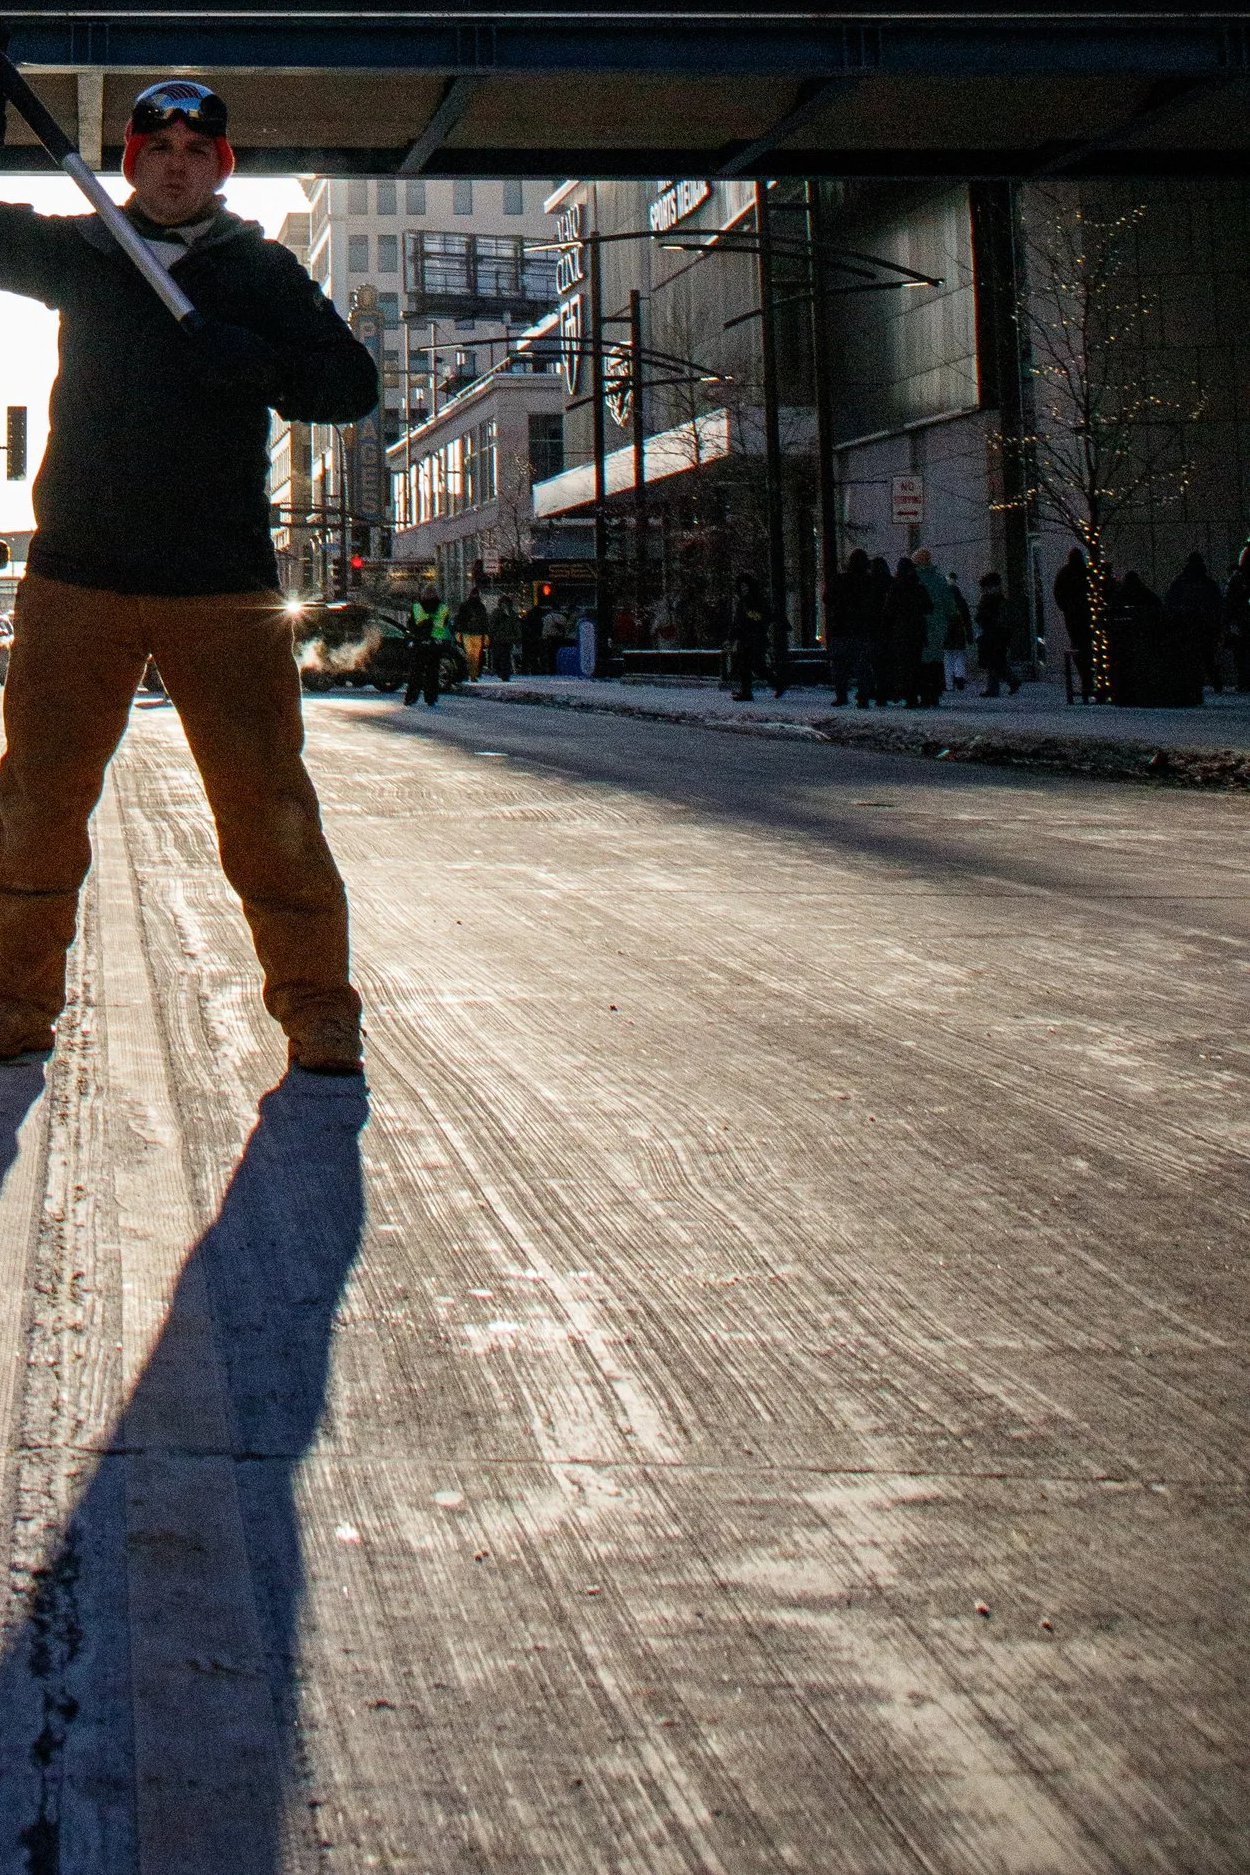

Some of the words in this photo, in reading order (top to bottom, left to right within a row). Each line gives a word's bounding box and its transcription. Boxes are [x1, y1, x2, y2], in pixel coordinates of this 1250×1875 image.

[649, 187, 677, 232] SPORTS
[358, 321, 378, 515] PAGES
[901, 481, 915, 493] NO
